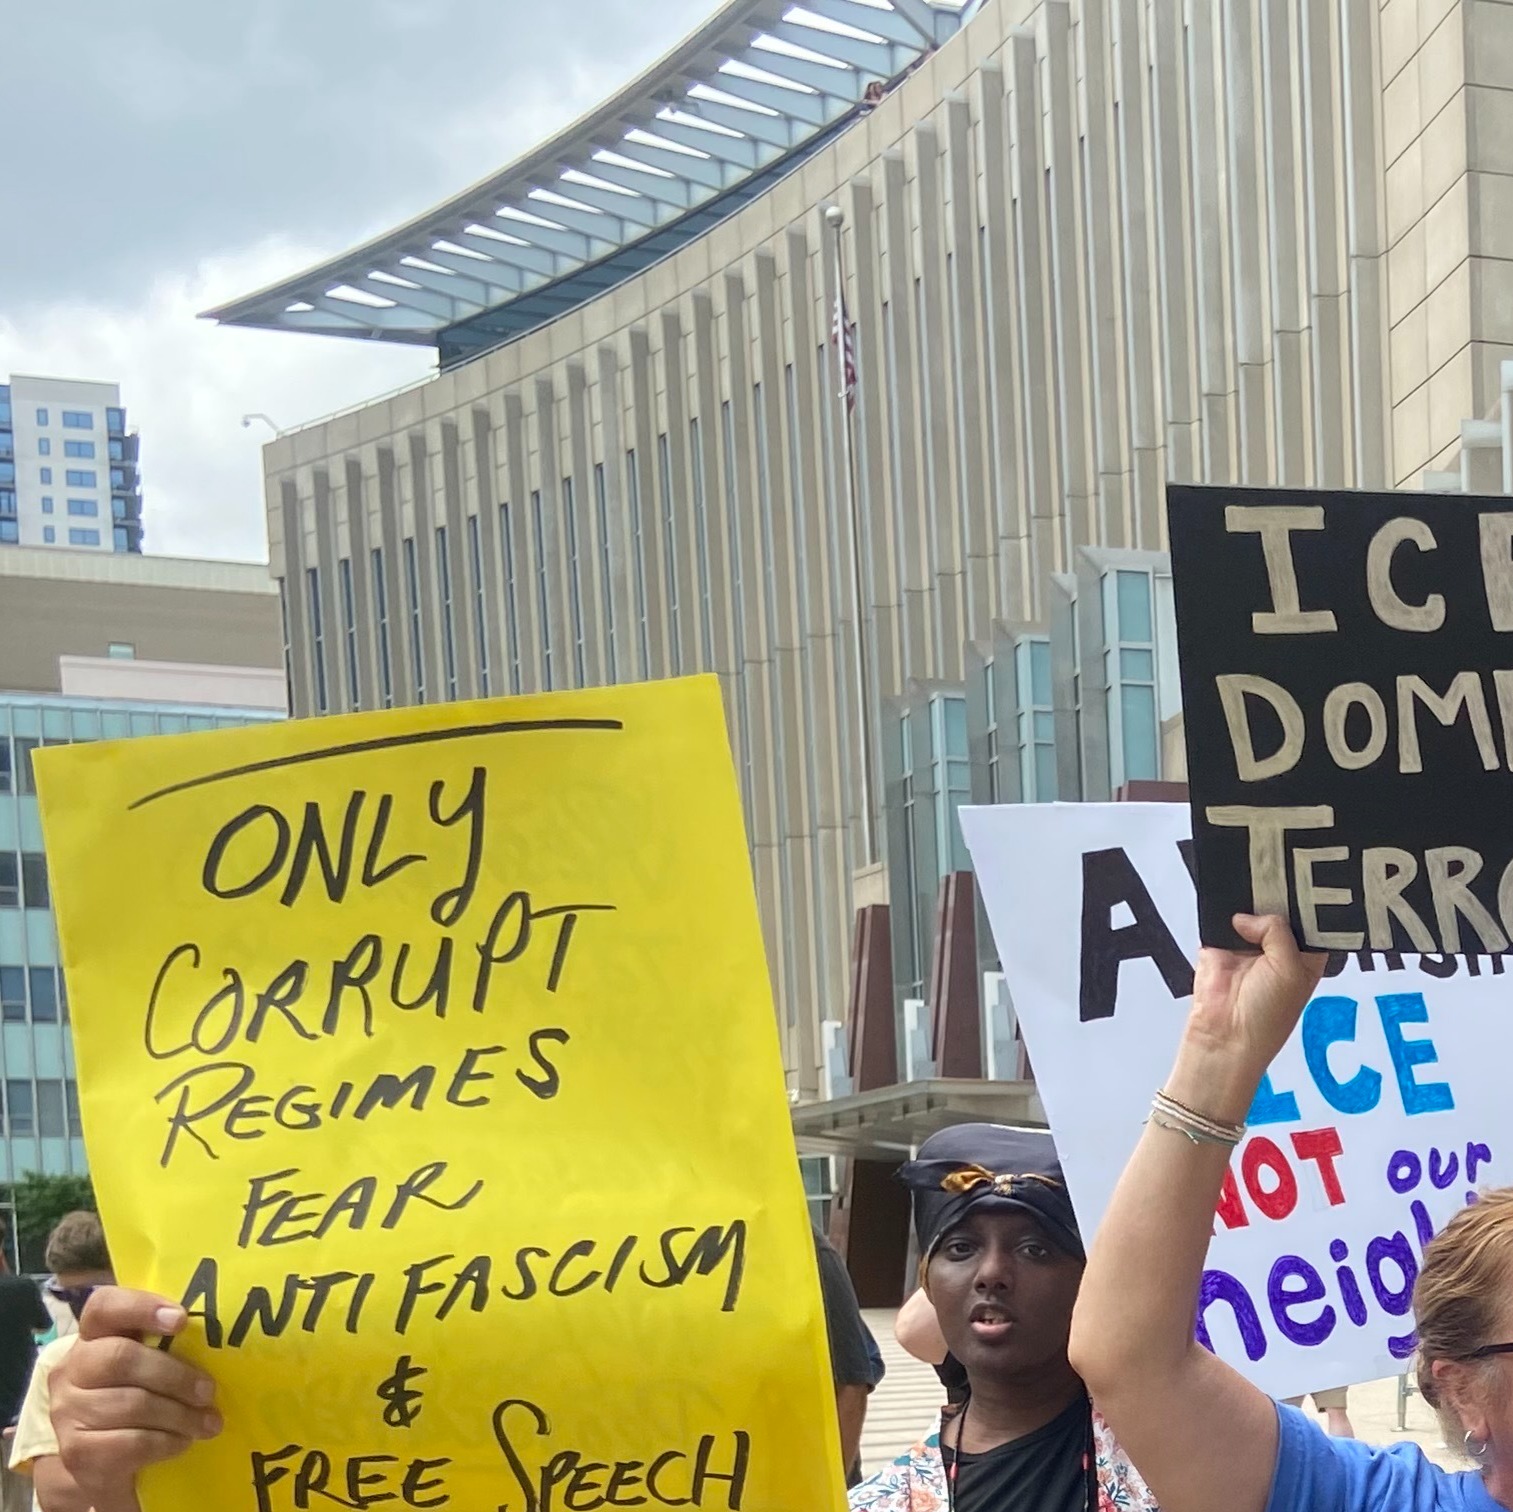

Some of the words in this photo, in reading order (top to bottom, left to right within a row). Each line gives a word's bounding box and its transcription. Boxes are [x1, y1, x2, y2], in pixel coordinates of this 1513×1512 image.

[202, 766, 487, 926] ONLY
[144, 891, 616, 1061] CORRUPT
[156, 1028, 569, 1167] REGIMES
[239, 1161, 484, 1249] FEAR
[1387, 1142, 1491, 1194] our
[376, 1355, 428, 1429] &
